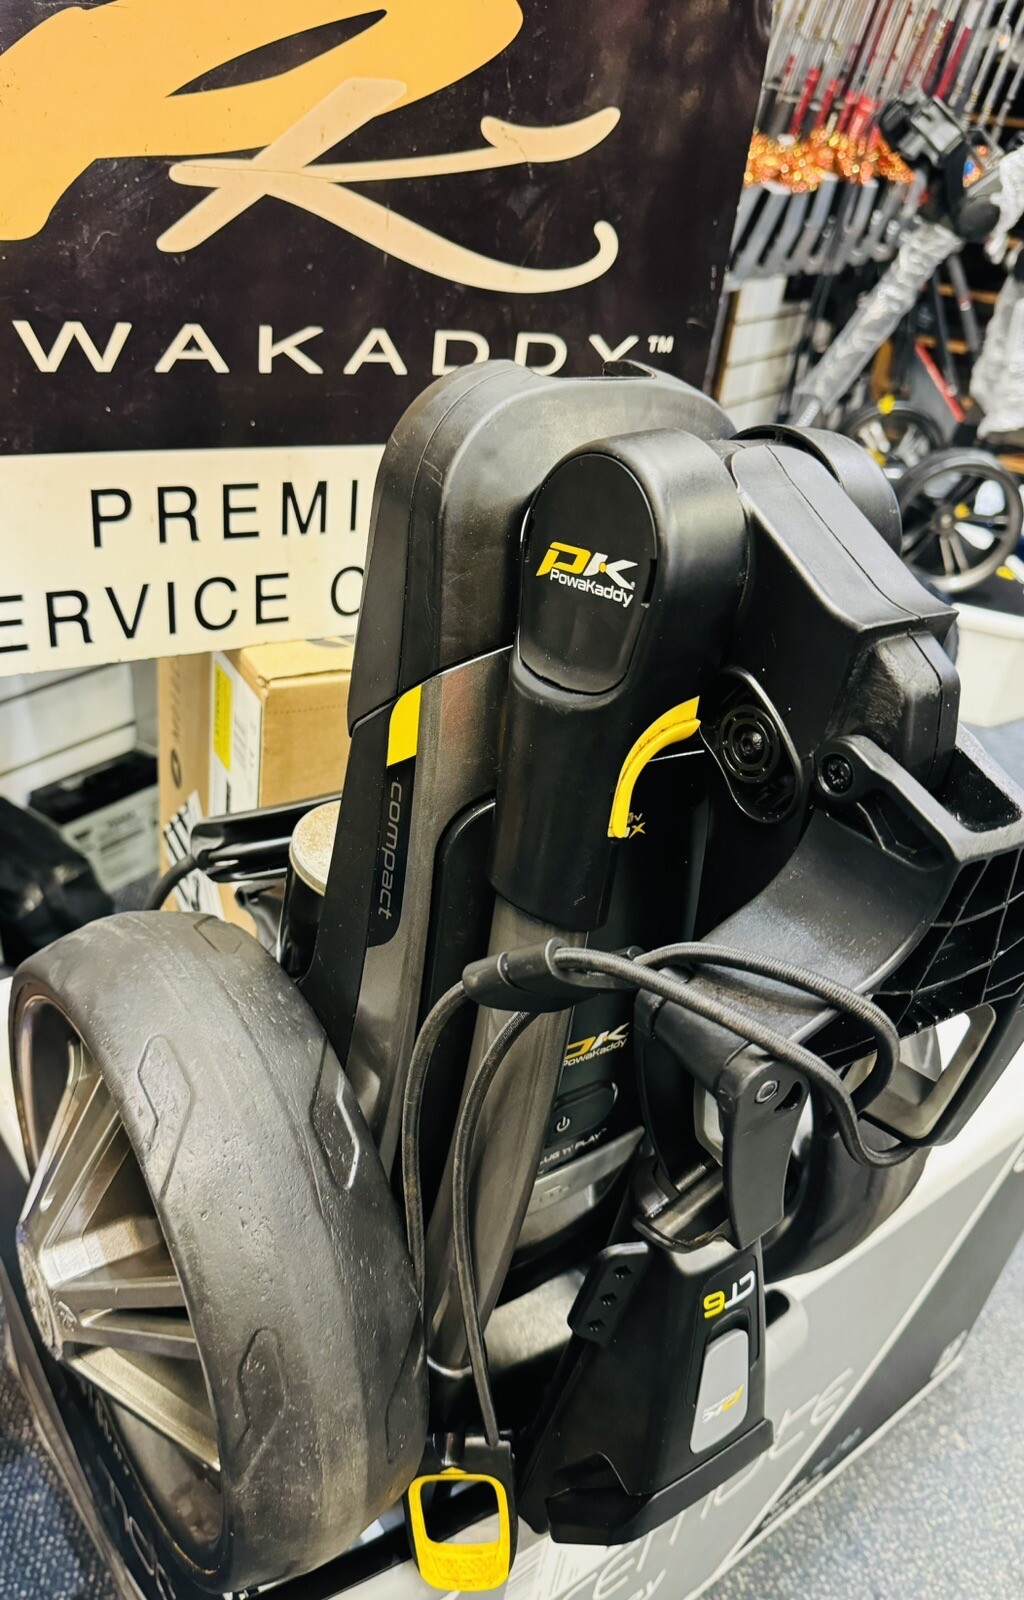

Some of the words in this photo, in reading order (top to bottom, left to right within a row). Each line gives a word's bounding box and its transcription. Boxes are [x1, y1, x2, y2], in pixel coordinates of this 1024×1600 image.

[12, 320, 639, 375] WAKADDY
[550, 568, 634, 608] PowaKaddy
[378, 781, 402, 921] compact
[703, 1270, 756, 1319] CT6
